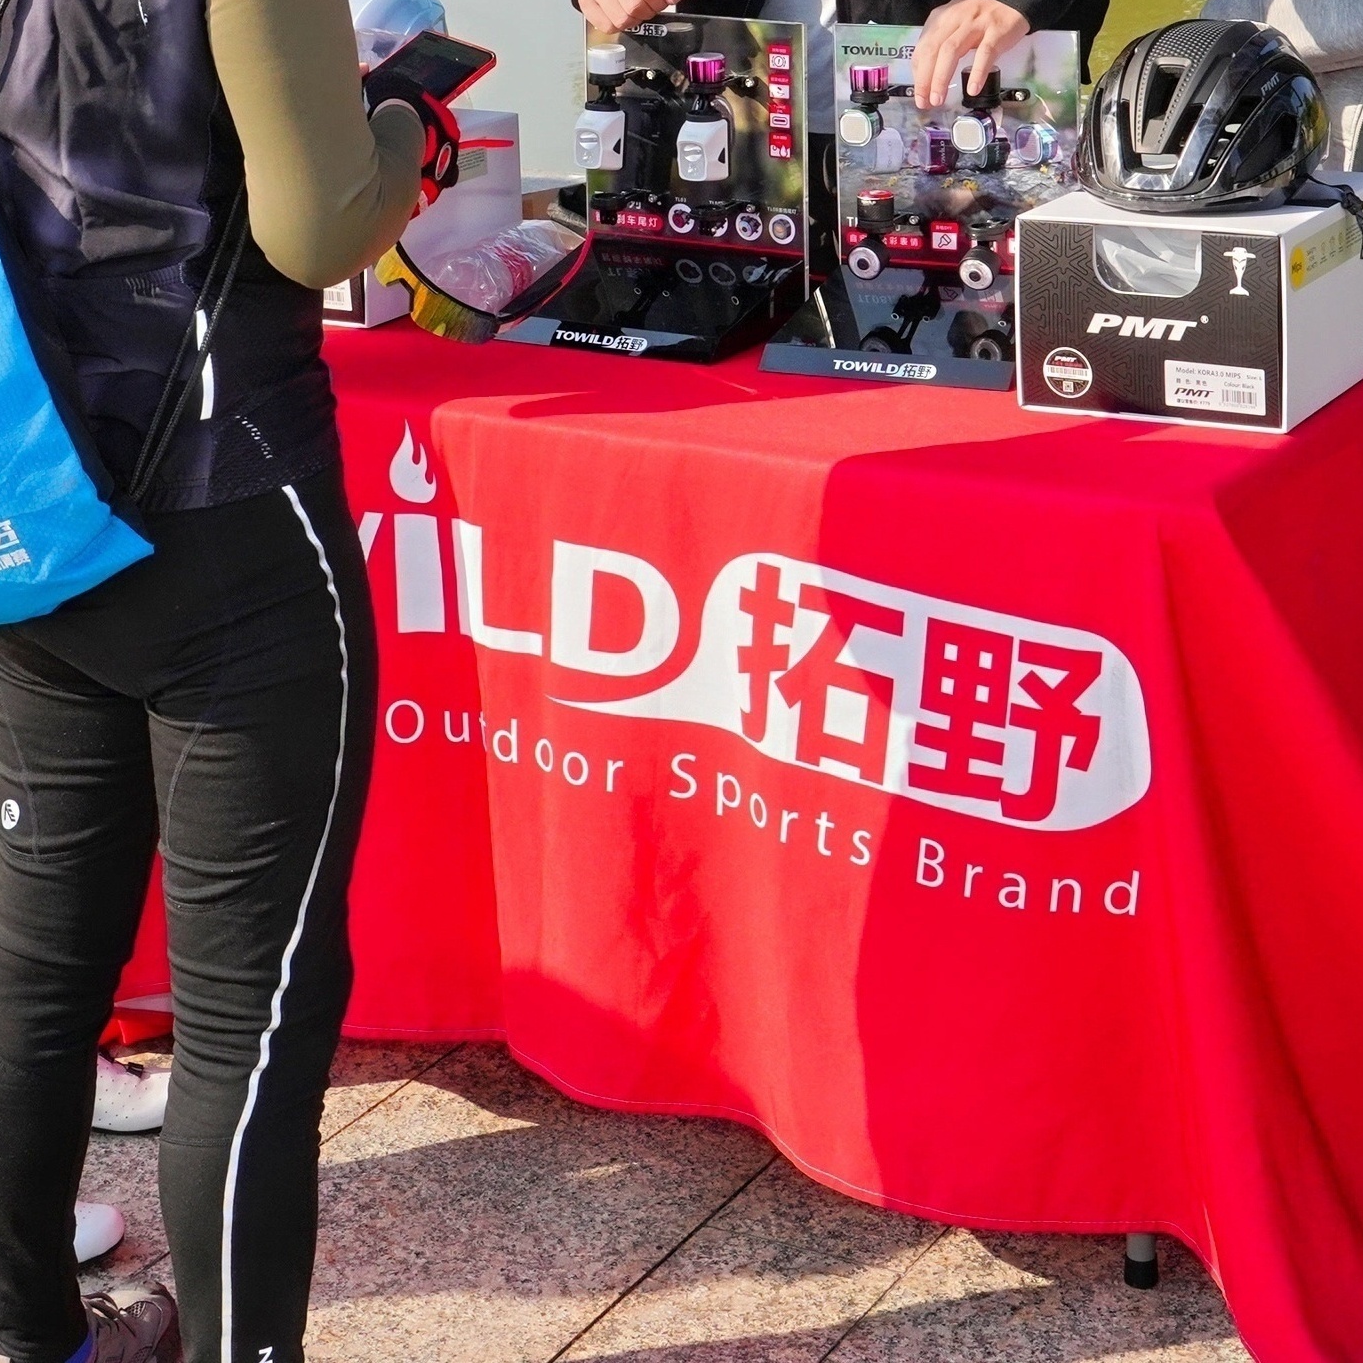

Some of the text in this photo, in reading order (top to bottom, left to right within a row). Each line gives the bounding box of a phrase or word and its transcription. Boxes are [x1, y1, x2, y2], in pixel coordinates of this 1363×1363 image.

[642, 23, 666, 36] 拓野
[1086, 312, 1197, 342] PMT
[615, 336, 645, 351] 拓野
[902, 364, 932, 378] 拓野
[1175, 387, 1214, 398] PMT
[734, 562, 1102, 823] 拓野
[385, 700, 1140, 916] Outdoor Sports Brand
